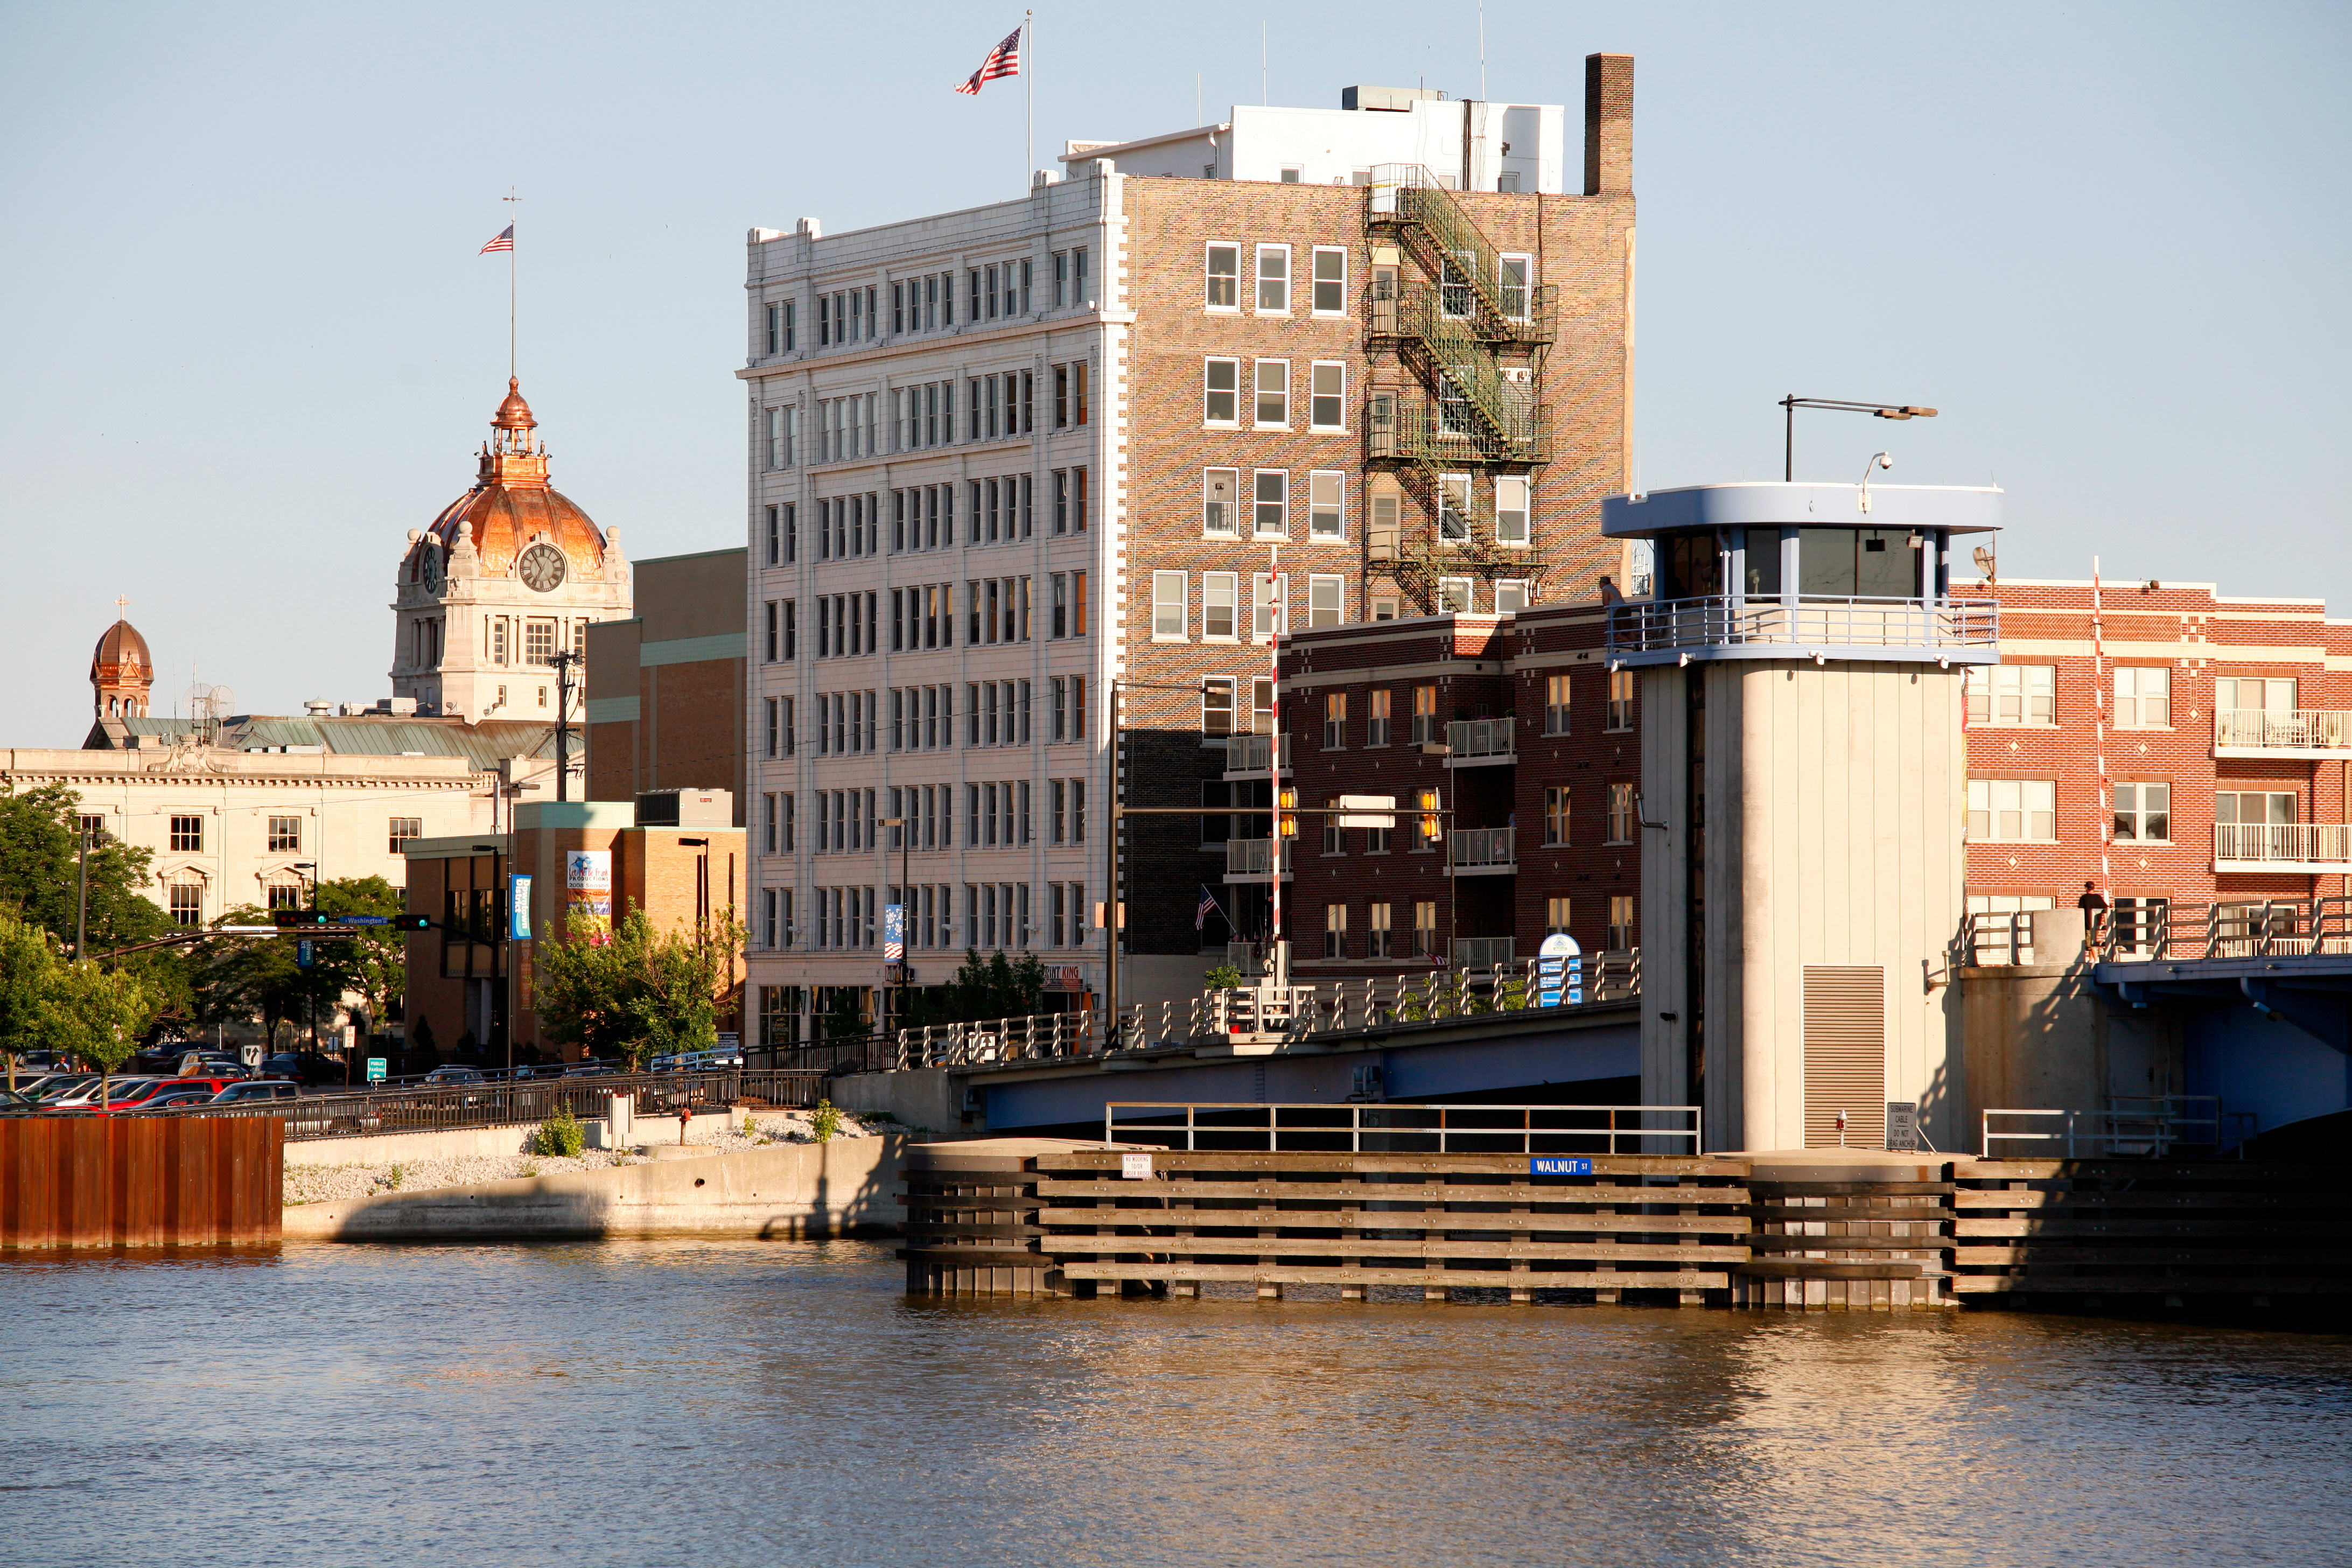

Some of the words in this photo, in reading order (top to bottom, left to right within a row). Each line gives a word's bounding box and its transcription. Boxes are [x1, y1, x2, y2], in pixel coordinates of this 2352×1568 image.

[515, 879, 523, 913] District
[521, 879, 530, 929] Downtown
[1044, 966, 1060, 978] RINT
[1062, 966, 1079, 978] KING
[1891, 1105, 1913, 1113] SUBMARINE
[1895, 1115, 1908, 1123] CABLE
[1536, 1160, 1578, 1173] WALNUT
